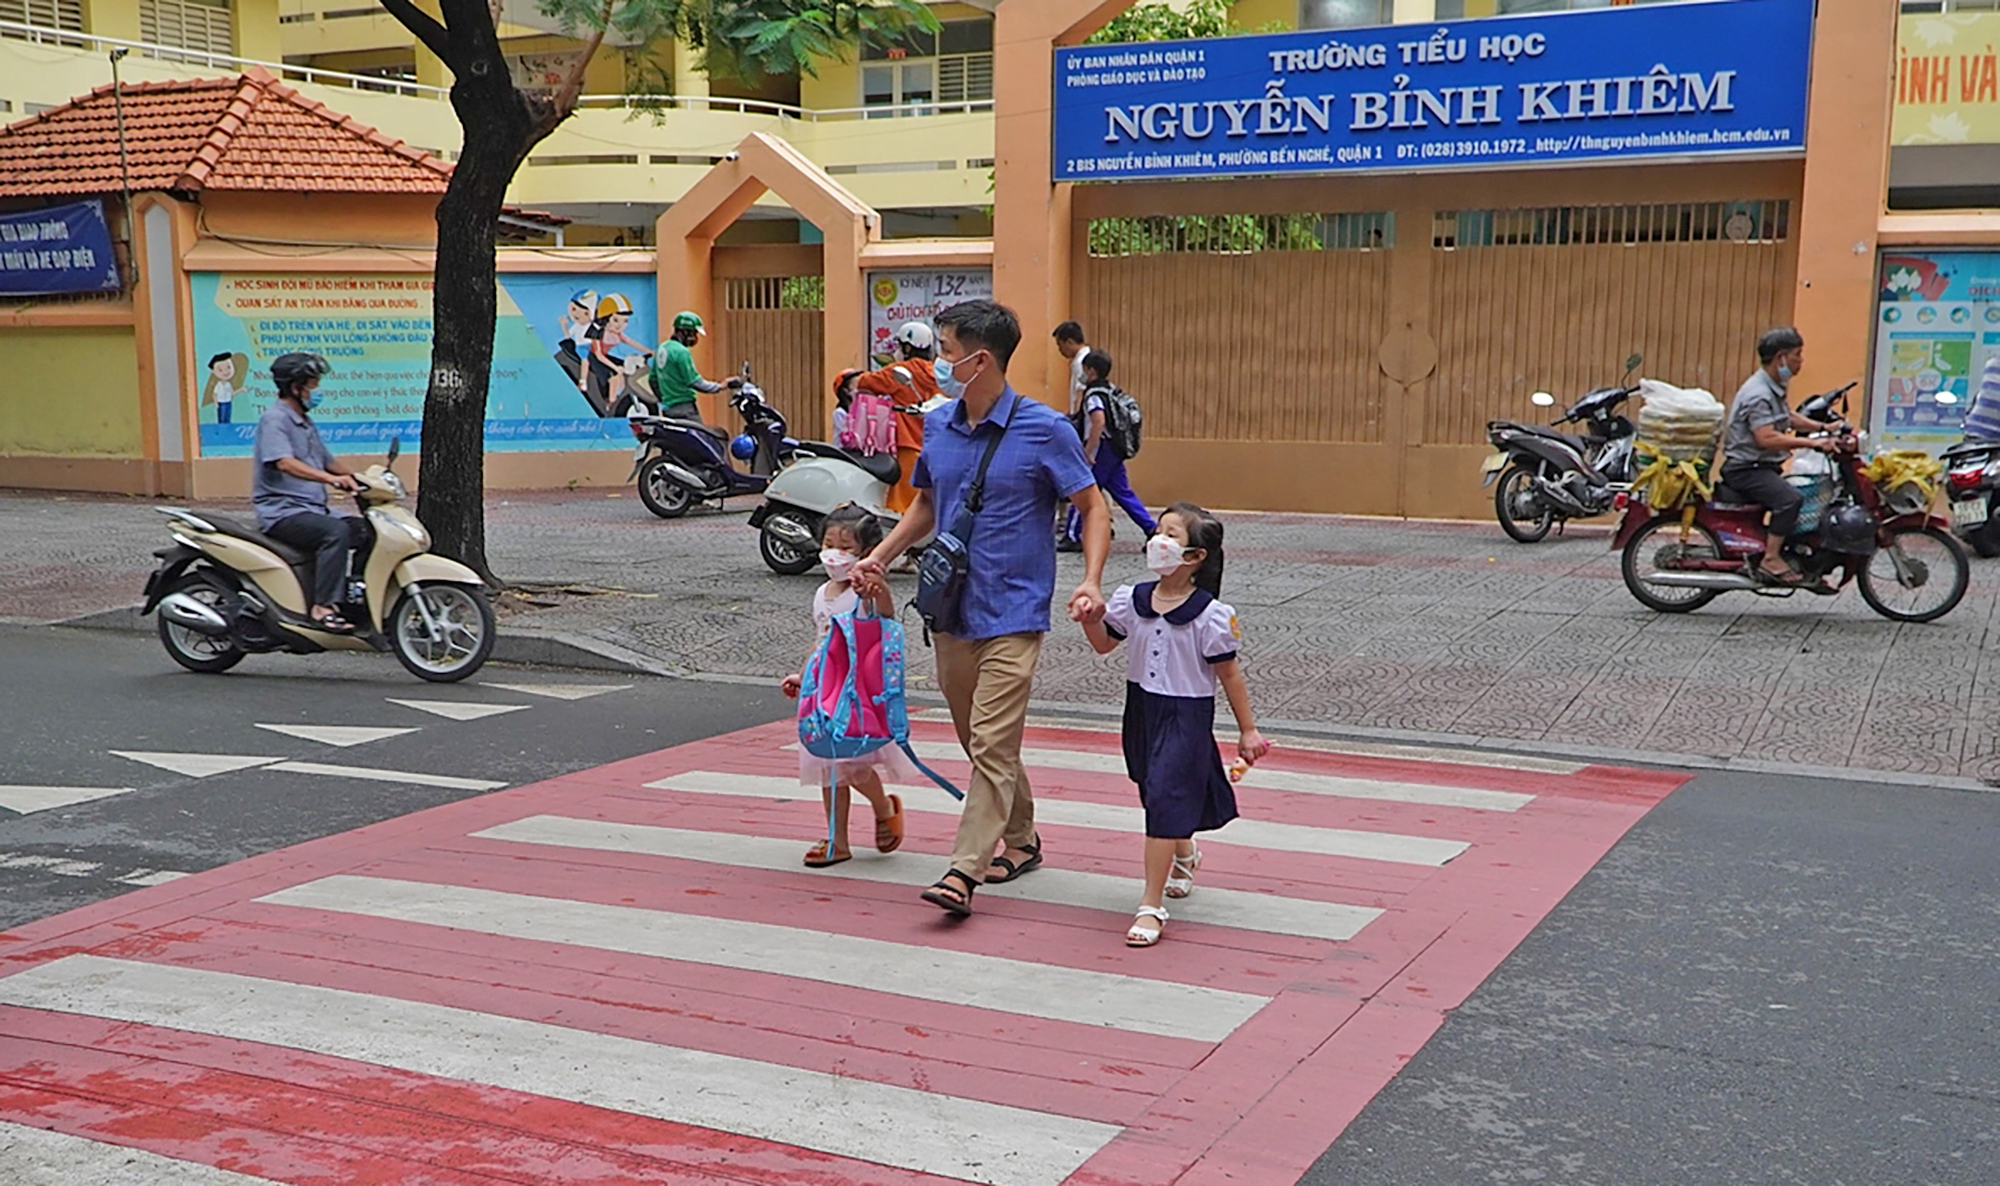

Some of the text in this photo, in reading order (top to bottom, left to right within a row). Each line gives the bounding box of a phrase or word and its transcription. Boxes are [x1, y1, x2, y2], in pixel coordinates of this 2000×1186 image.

[1067, 48, 1205, 70] ỦY BAN NHÂN DÂN QUẬN 1
[1269, 28, 1546, 72] TRƯỜNG TIỂU HỌC
[1067, 72, 1099, 87] PHÒNG
[1101, 70, 1124, 85] GIÁO
[1125, 71, 1147, 85] DỤC
[1147, 67, 1161, 82] VÀ
[1185, 67, 1206, 82] TẠO
[1899, 44, 1997, 104] ÌNH VÀ
[1104, 64, 1737, 142] NGUYỄN BỈNH KHIÊM
[1067, 160, 1075, 173] 2
[1076, 158, 1095, 172] BIS
[1097, 152, 1142, 171] NGUYỄN
[1174, 151, 1216, 168] KHIÊM,
[1218, 148, 1268, 166] PHƯỜNG
[1270, 145, 1296, 163] BẾN
[1297, 145, 1334, 163] NGHÉ,
[1337, 143, 1371, 163] QUẬN
[1375, 146, 1382, 159] 1
[255, 280, 280, 290] SINH
[360, 280, 376, 290] KHI
[377, 280, 404, 290] THAM
[933, 274, 967, 296] 132
[235, 298, 261, 308] QUAN
[285, 299, 298, 308] AN
[326, 299, 340, 308] KHI
[369, 299, 386, 308] QUA
[285, 334, 320, 343] HUYNH
[323, 334, 341, 343] VUI
[372, 331, 405, 342] KHÔNG
